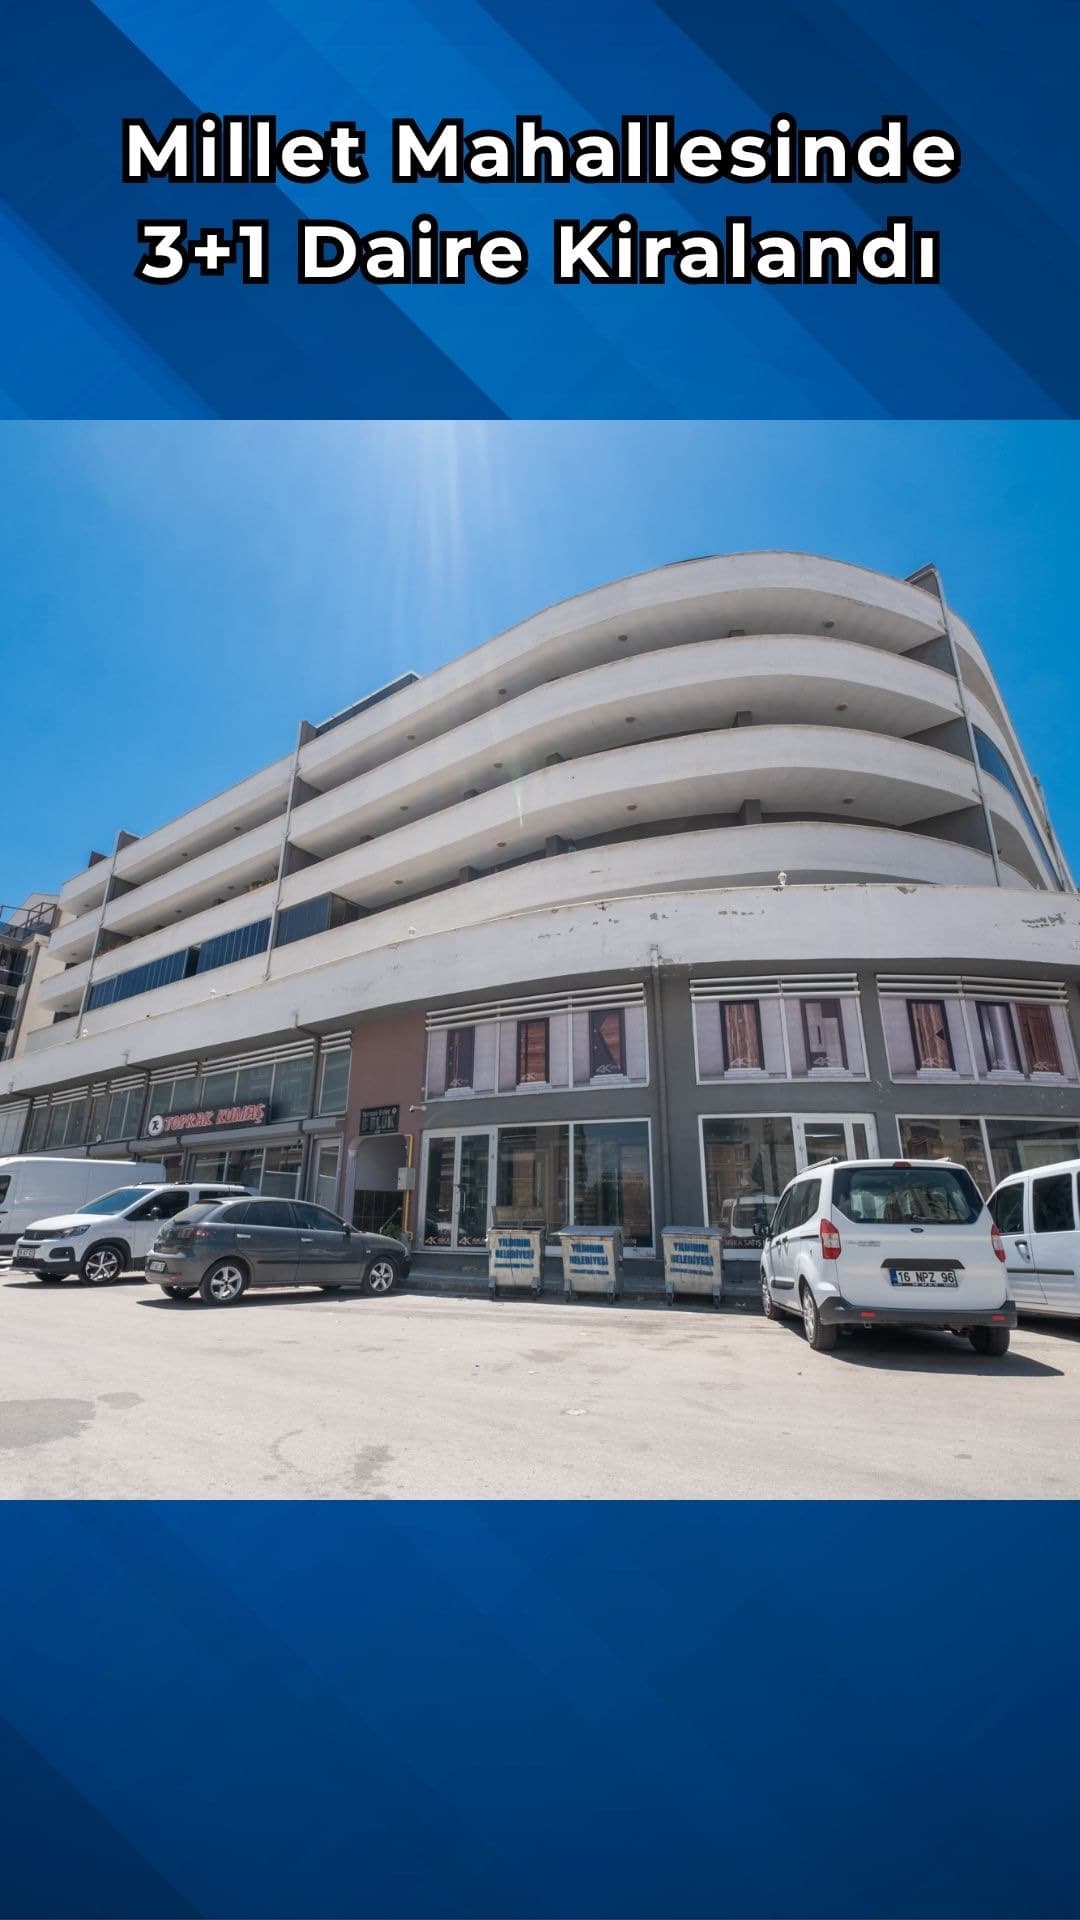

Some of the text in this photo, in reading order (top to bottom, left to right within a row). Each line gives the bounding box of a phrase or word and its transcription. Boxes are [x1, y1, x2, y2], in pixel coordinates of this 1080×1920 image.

[165, 1103, 266, 1131] TOPRAK KUMAŞ
[498, 1238, 531, 1248] YILDIRIM
[571, 1243, 605, 1254] YILDIRIM
[673, 1242, 709, 1253] YILDIRIM
[898, 1271, 955, 1283] 16 NPZ 96
